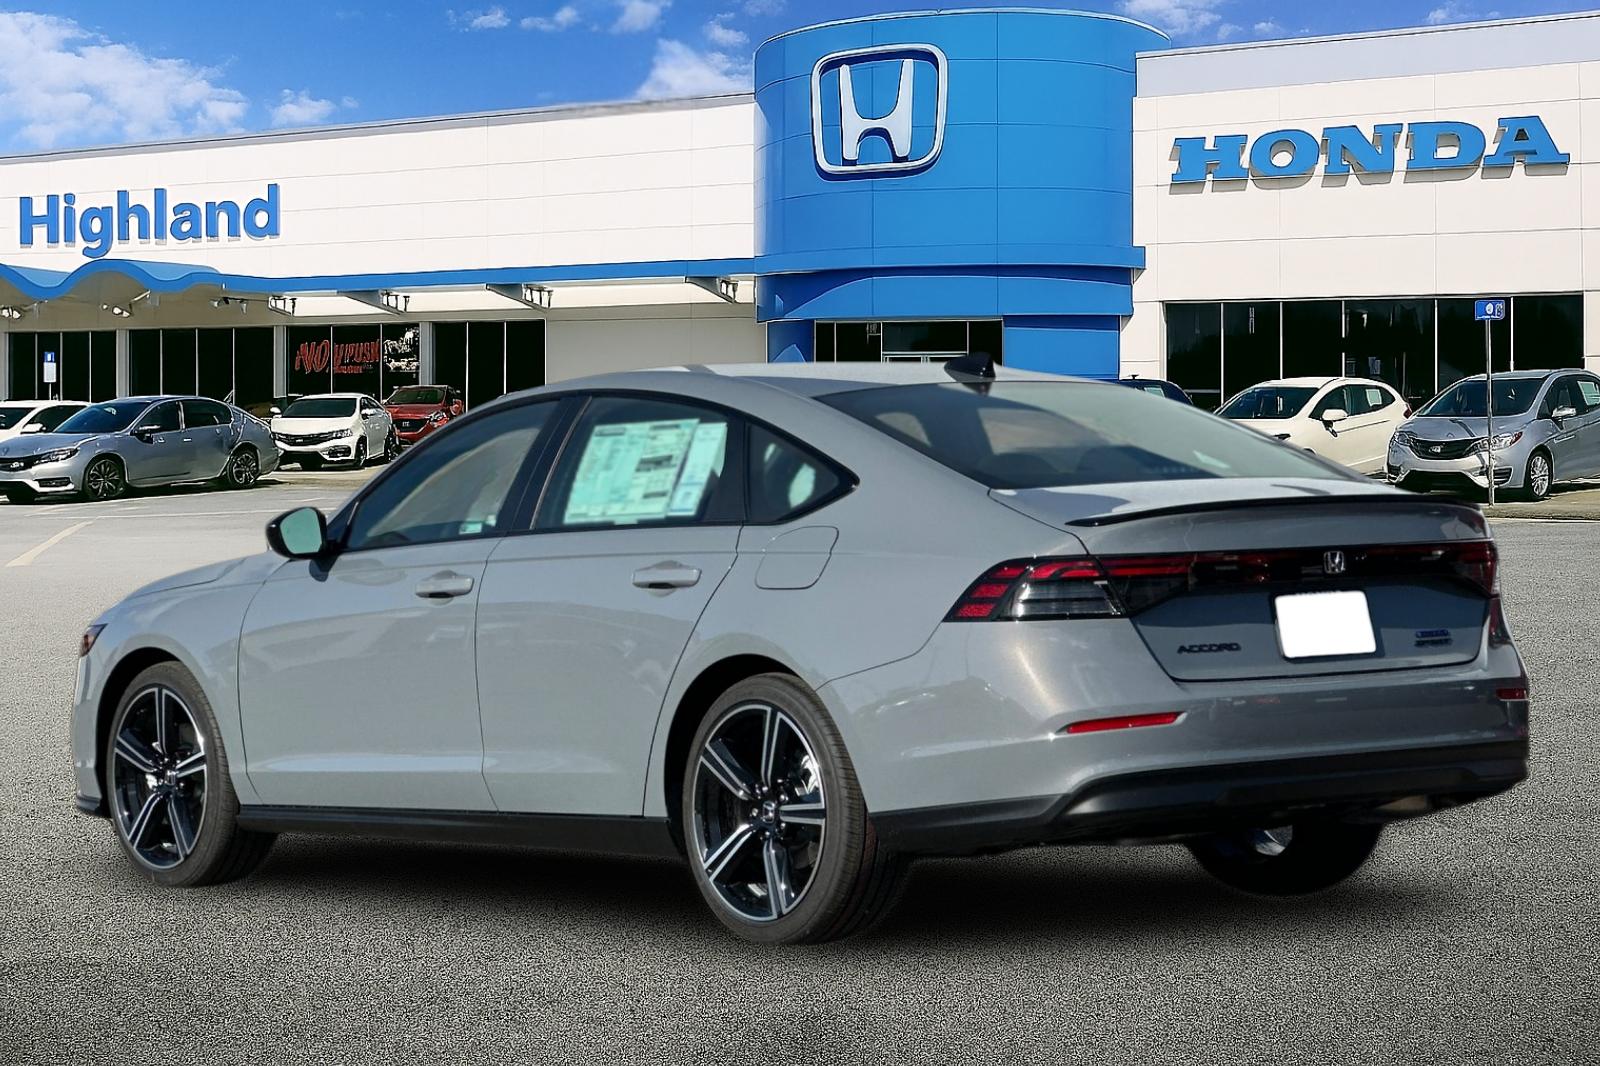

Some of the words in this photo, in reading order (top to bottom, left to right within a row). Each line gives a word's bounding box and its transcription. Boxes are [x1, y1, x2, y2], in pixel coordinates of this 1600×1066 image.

[1170, 115, 1569, 185] HONDA
[20, 183, 279, 258] Highland
[1177, 642, 1242, 655] ACCORD
